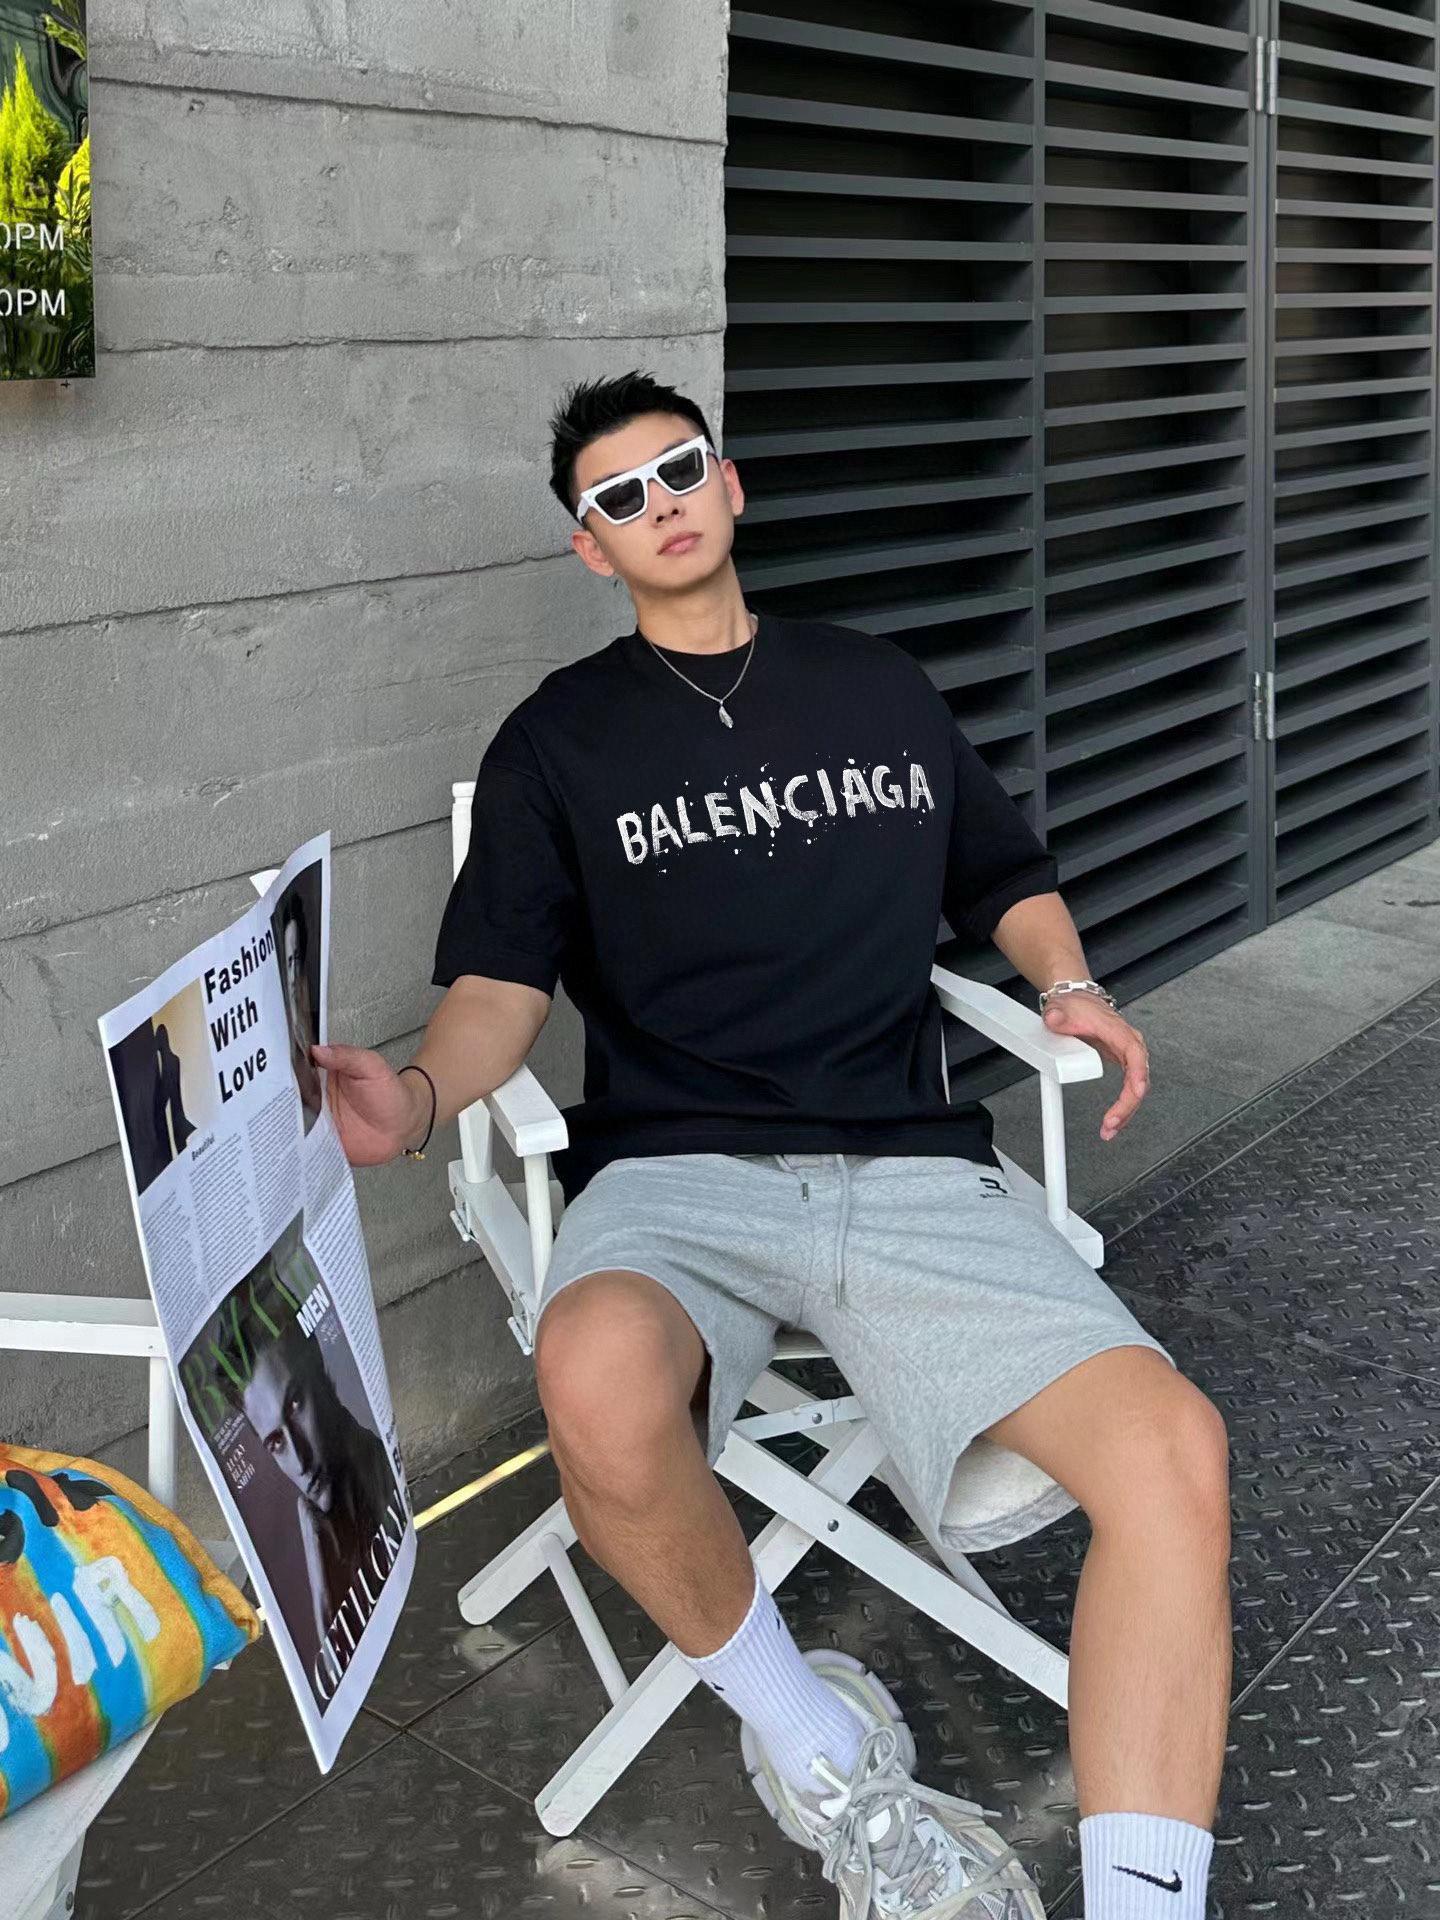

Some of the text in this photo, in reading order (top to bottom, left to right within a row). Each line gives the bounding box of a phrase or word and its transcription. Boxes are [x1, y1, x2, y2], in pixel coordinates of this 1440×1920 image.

[616, 763, 936, 865] BALENCIAGA
[204, 929, 274, 1005] Fashion
[210, 996, 259, 1053] With
[218, 1047, 268, 1104] Love
[296, 1282, 331, 1339] MEN
